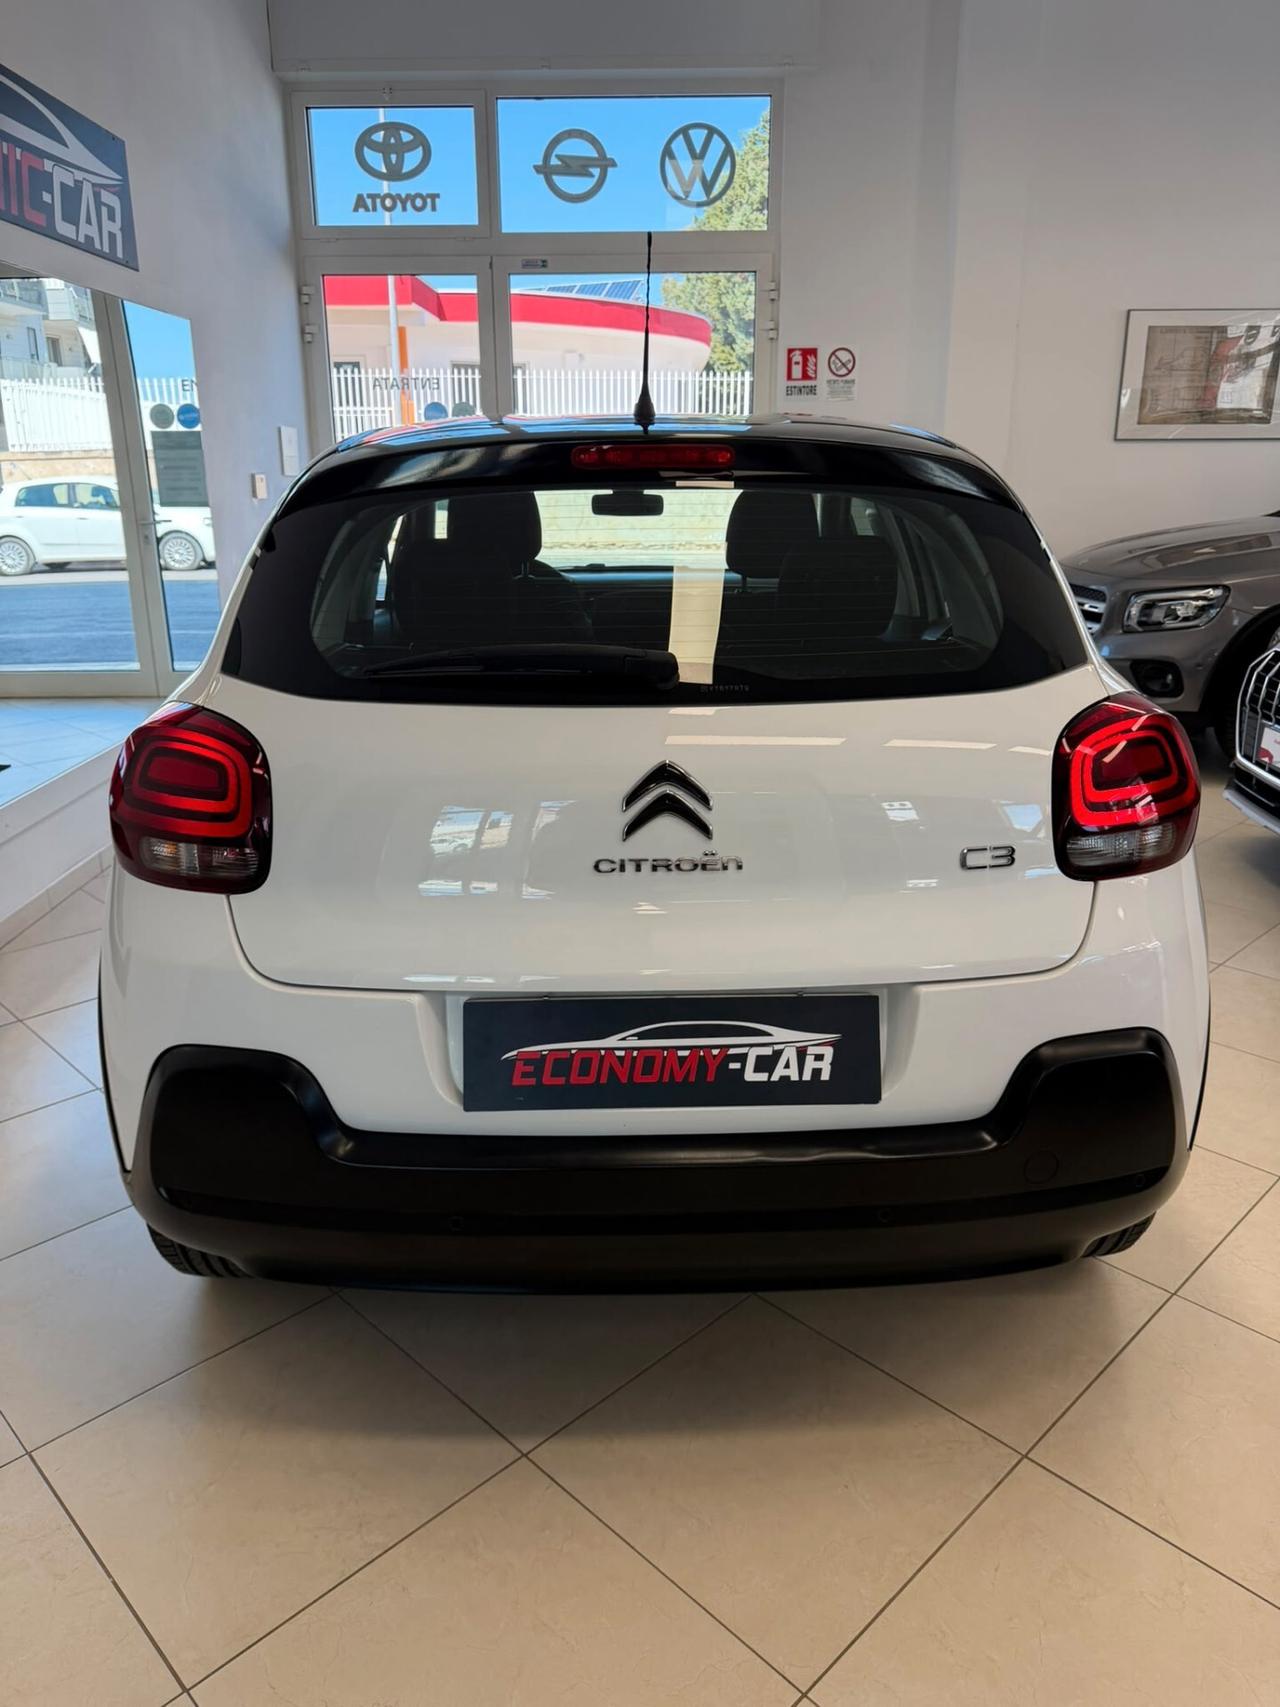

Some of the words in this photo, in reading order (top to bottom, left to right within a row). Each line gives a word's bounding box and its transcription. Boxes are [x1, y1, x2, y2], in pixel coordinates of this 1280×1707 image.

[0, 139, 123, 259] IC-CAR
[785, 385, 817, 396] ESTINTORE
[960, 845, 1016, 870] C3
[511, 1046, 834, 1086] ECONOMY-CAR
